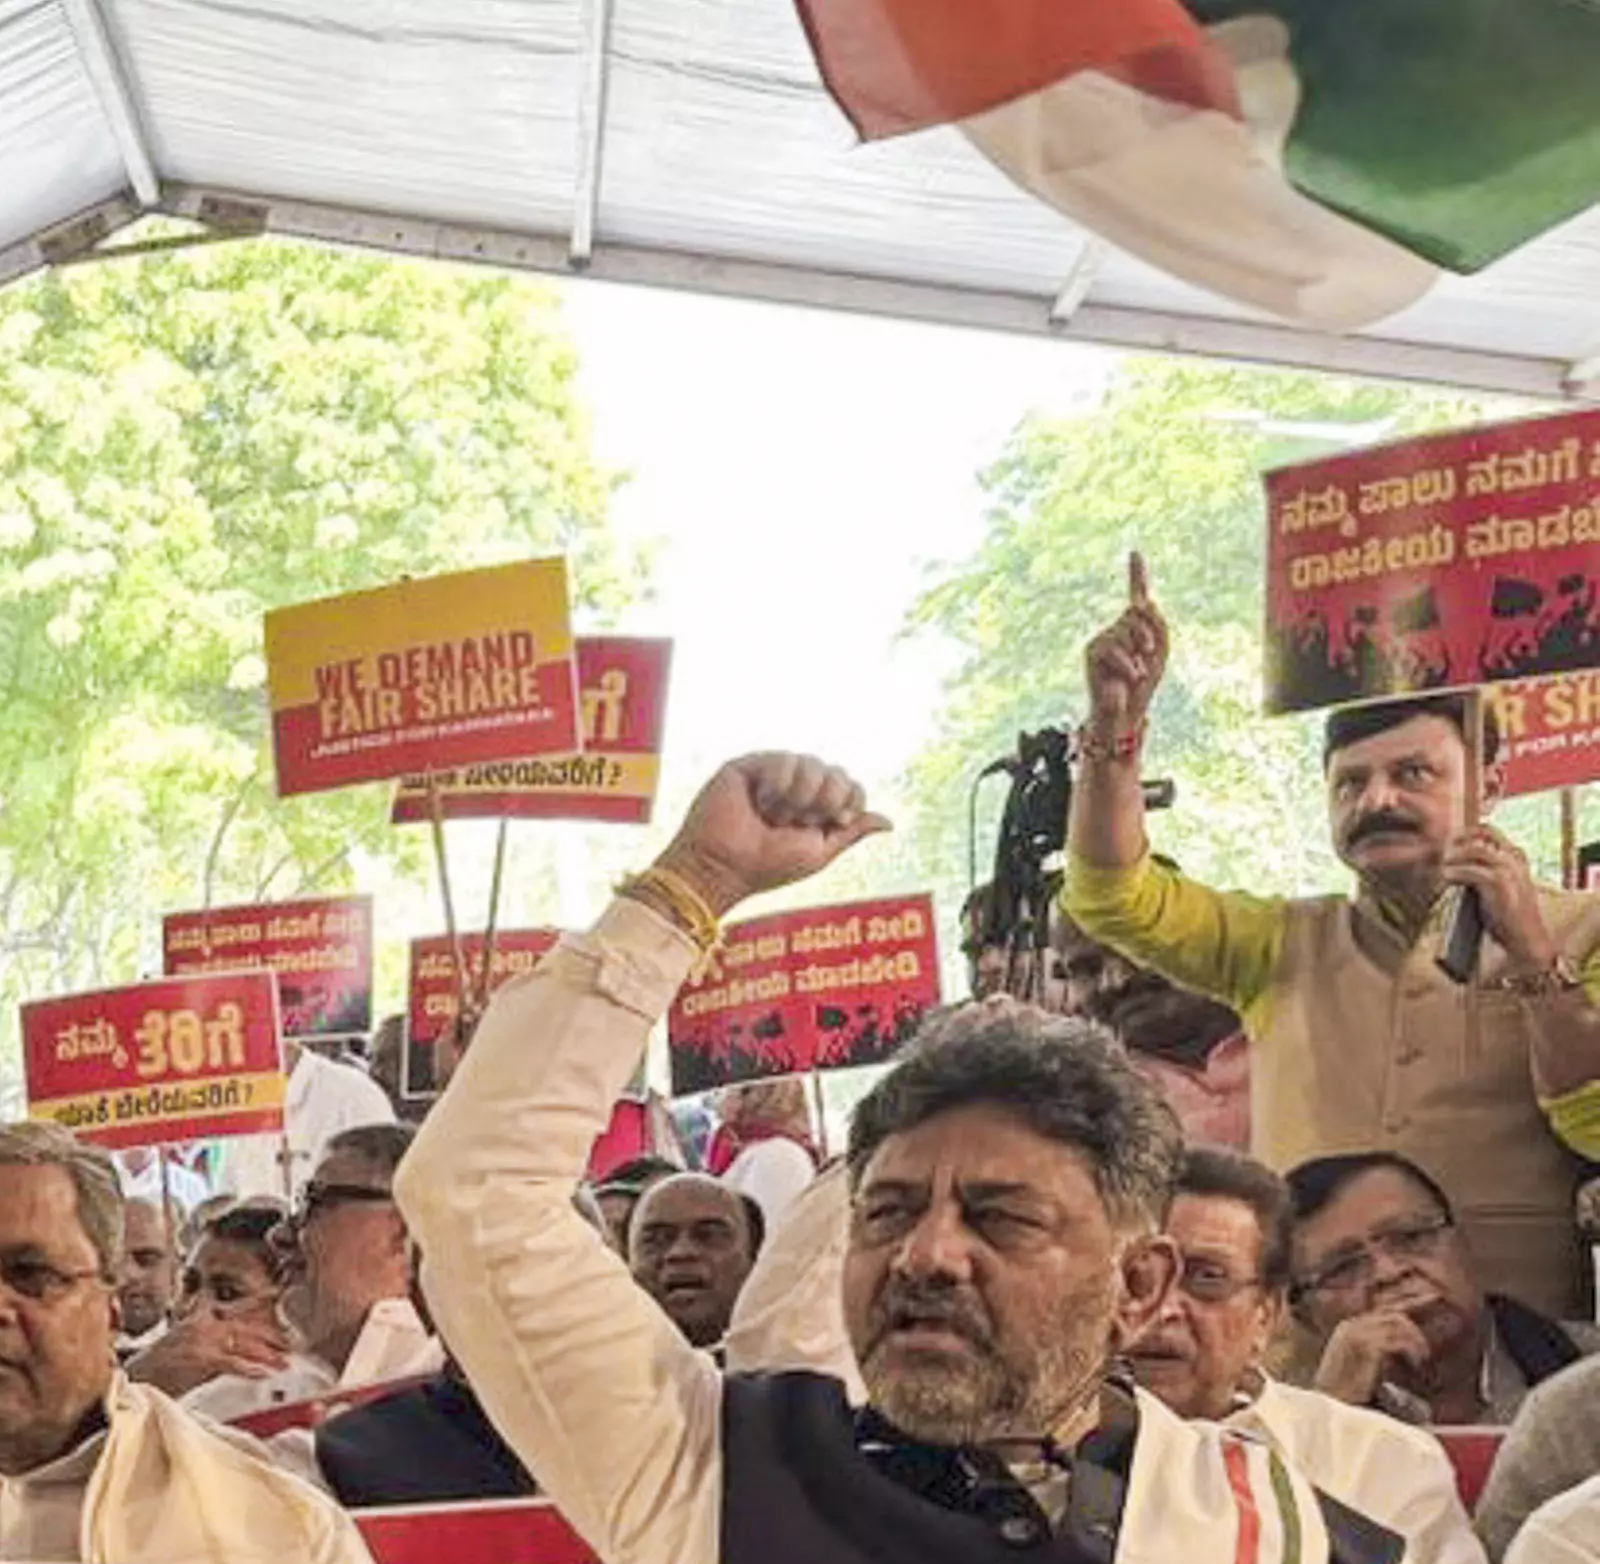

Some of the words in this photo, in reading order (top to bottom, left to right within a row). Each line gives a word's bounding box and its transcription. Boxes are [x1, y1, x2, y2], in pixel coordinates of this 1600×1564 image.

[1281, 486, 1357, 539] ನಮ್ಮ
[1468, 438, 1578, 498] ನಮಗೆ
[314, 658, 363, 698] WE
[378, 631, 533, 690] DEMAND
[318, 688, 402, 738] FAIR
[418, 666, 540, 720] SHARE
[55, 1016, 129, 1069] ನಮ್ಮ
[135, 1004, 245, 1077] ತೆರಿಗೆ
